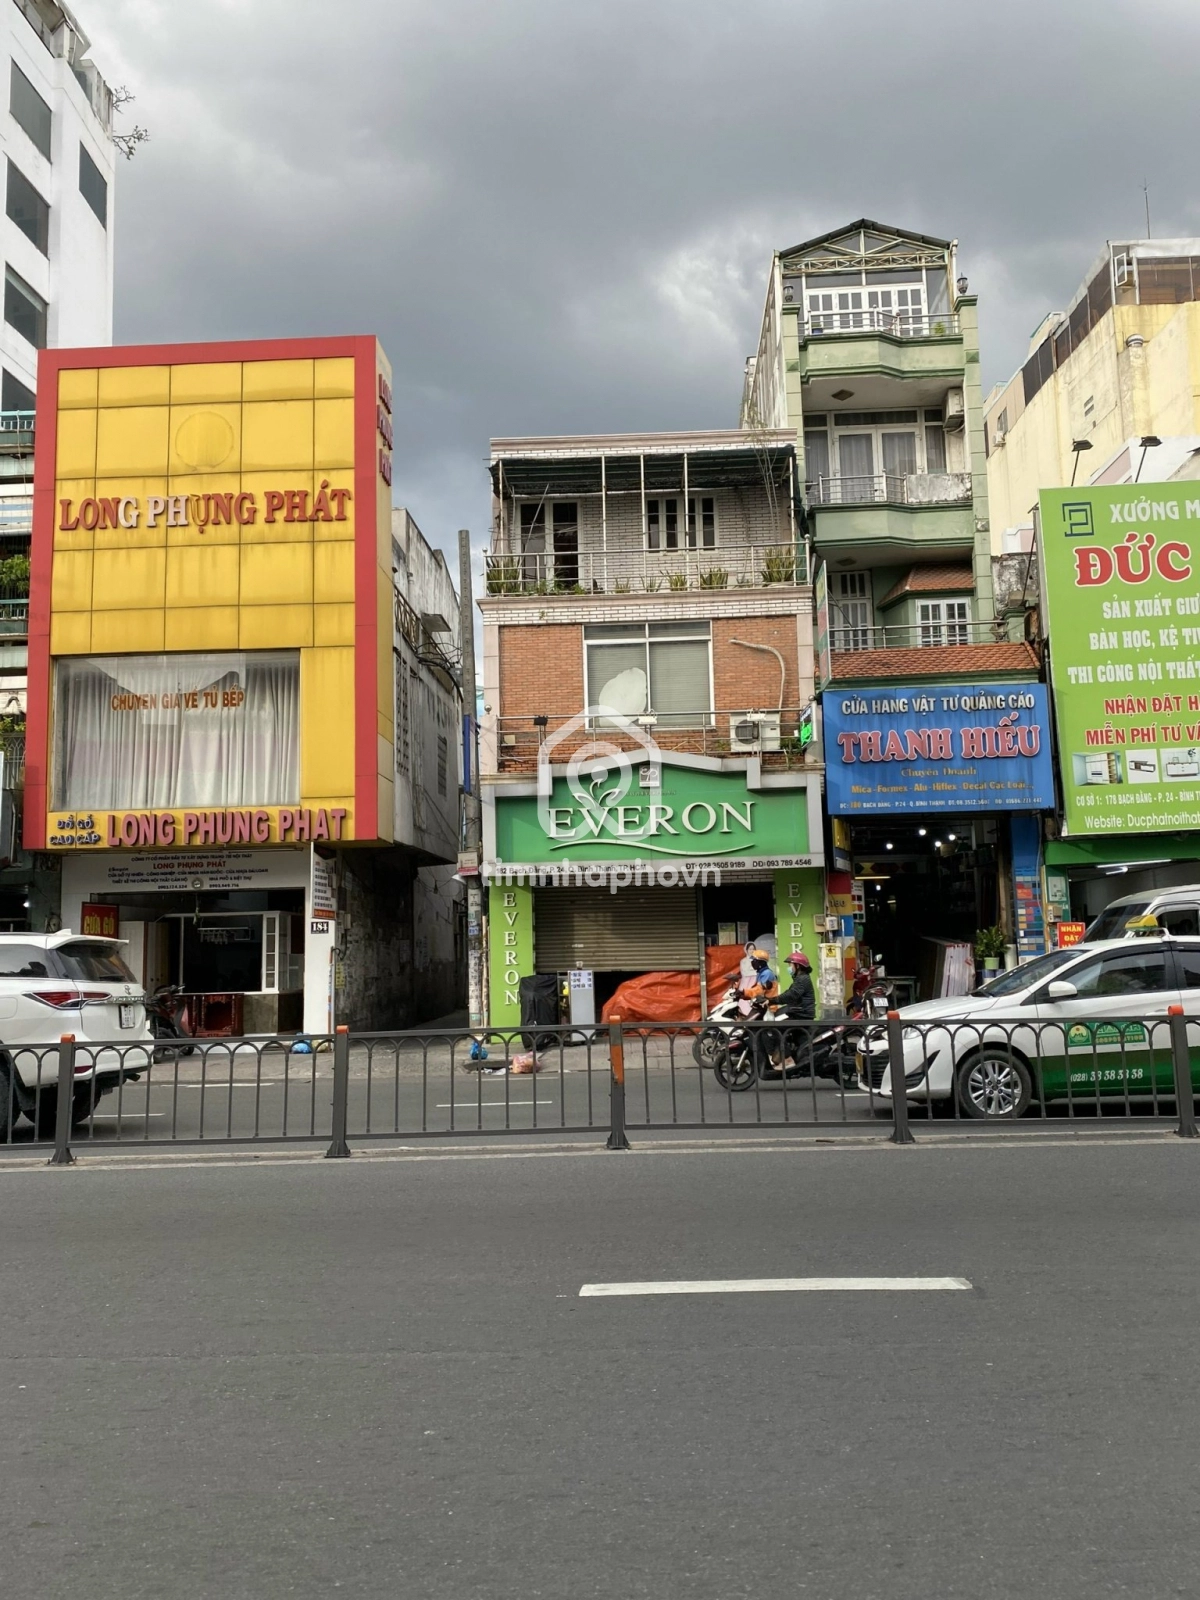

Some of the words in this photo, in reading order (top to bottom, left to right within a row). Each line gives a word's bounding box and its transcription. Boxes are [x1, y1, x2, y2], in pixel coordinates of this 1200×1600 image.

[59, 496, 140, 530] LONG
[147, 492, 258, 534] PHỤNG
[264, 479, 351, 523] PHÁT
[1110, 496, 1179, 523] XƯỞNG
[1073, 532, 1192, 587] ĐỨC
[1102, 594, 1131, 619] SẢN
[1135, 592, 1171, 617] XUẤT
[1089, 628, 1118, 650] BÀN
[1122, 630, 1155, 652] HỌC,
[1159, 624, 1178, 650] KỆ
[1068, 666, 1093, 684] THI
[1097, 660, 1133, 682] CÔNG
[1138, 658, 1163, 685] NỘI
[162, 692, 180, 708] GIA
[204, 685, 218, 708] TỦ
[222, 684, 244, 707] BẾP
[842, 694, 868, 714] CỬA
[912, 695, 935, 716] VẬT
[941, 695, 960, 711] TƯ
[961, 691, 1005, 710] QUẢNG
[1008, 691, 1035, 708] CÁO
[1105, 694, 1147, 717] NHẬN
[1152, 693, 1182, 717] ĐẶT
[838, 728, 953, 763] THANH
[960, 712, 1040, 759] HIẾU
[1086, 721, 1126, 746] MIỄN
[1130, 723, 1157, 743] PHÍ
[1161, 723, 1182, 742] TƯ
[851, 785, 871, 794] Mica
[877, 784, 908, 793] Formex
[914, 783, 927, 792] Alu
[963, 782, 987, 790] Decal
[1096, 796, 1102, 805] 1:
[1105, 795, 1116, 805] 178
[1119, 794, 1135, 806] BẠCH
[1166, 792, 1173, 802] 24
[108, 813, 175, 846] LONG
[279, 808, 346, 842] PHAT
[546, 801, 755, 838] EVERON
[1085, 815, 1125, 828] Website:
[50, 835, 75, 845] CAO
[207, 859, 226, 868] PHÁT
[312, 923, 328, 931] 184
[1061, 924, 1082, 932] NHẬN
[504, 893, 519, 1005] EVERON
[1071, 1073, 1088, 1082] (028)
[1104, 1070, 1115, 1080] 38
[1131, 1068, 1143, 1079] 38
